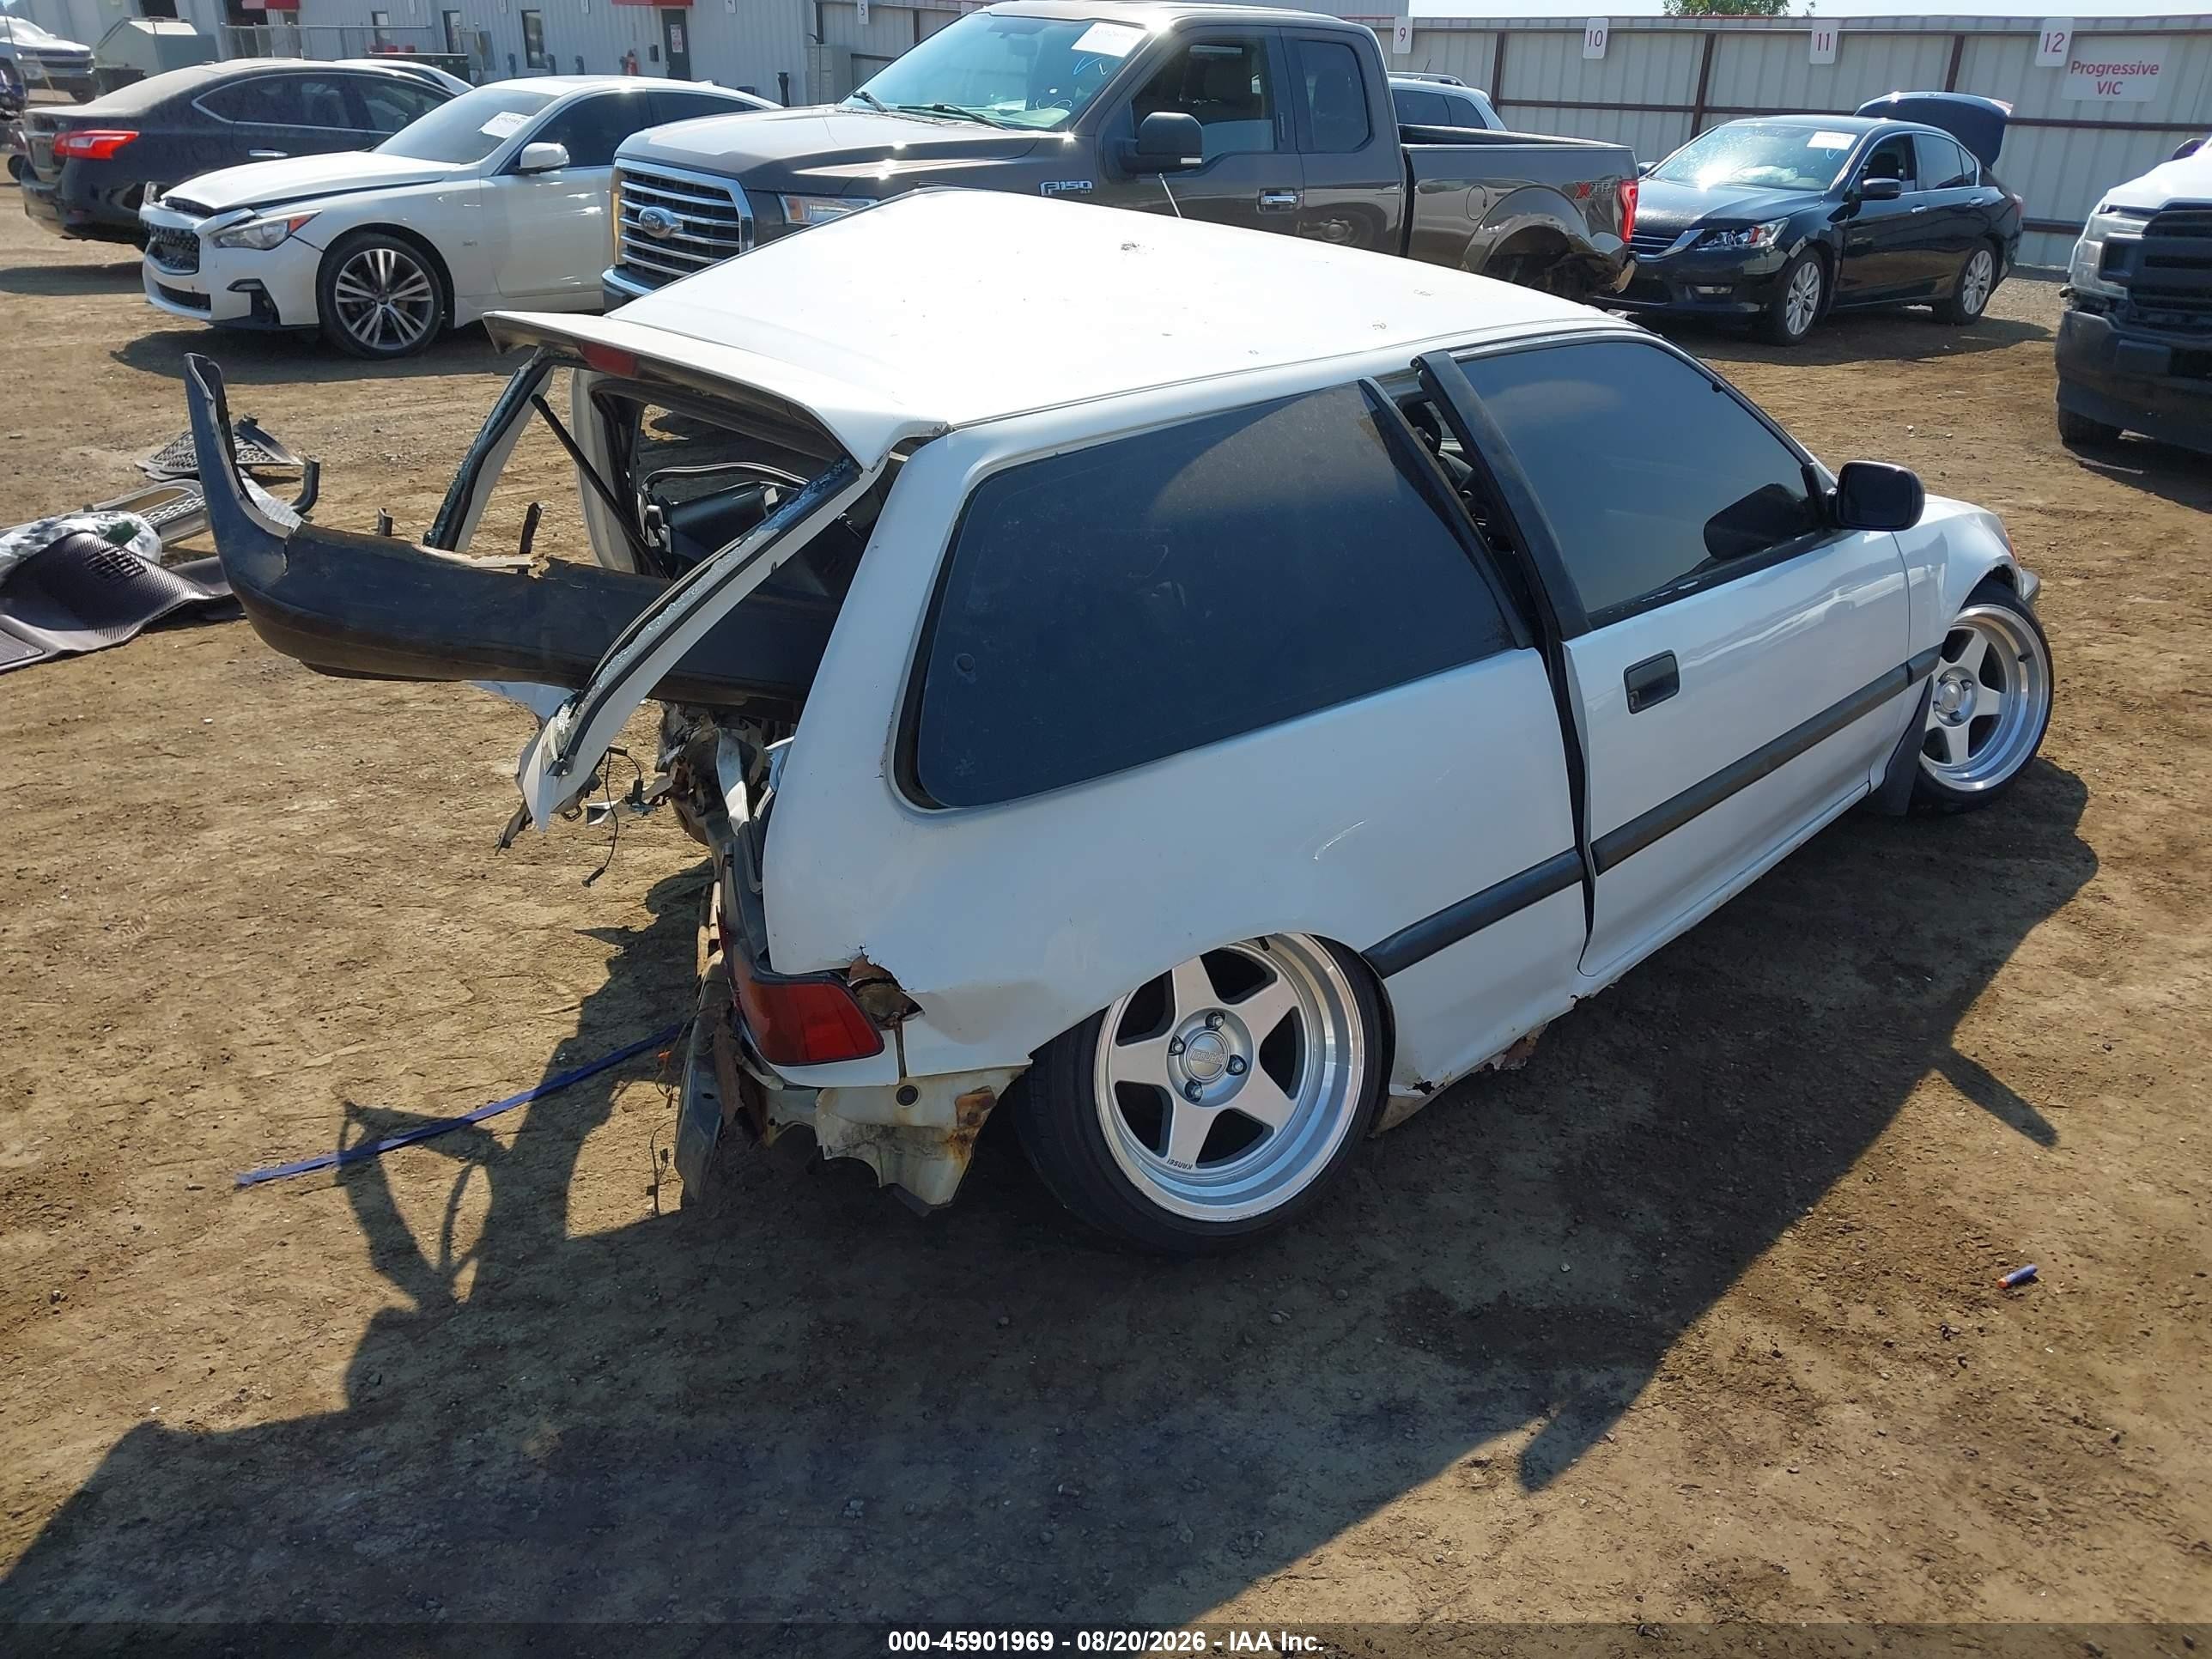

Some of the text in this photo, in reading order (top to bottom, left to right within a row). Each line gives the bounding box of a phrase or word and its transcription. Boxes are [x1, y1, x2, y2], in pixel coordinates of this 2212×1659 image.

[1399, 27, 1407, 42] 9
[1589, 29, 1603, 47] 10
[1817, 32, 1831, 52] 11
[2044, 32, 2065, 53] 12
[2069, 60, 2160, 77] Progressive
[2096, 81, 2124, 95] VIC
[1166, 1158, 1194, 1170] KANSEI
